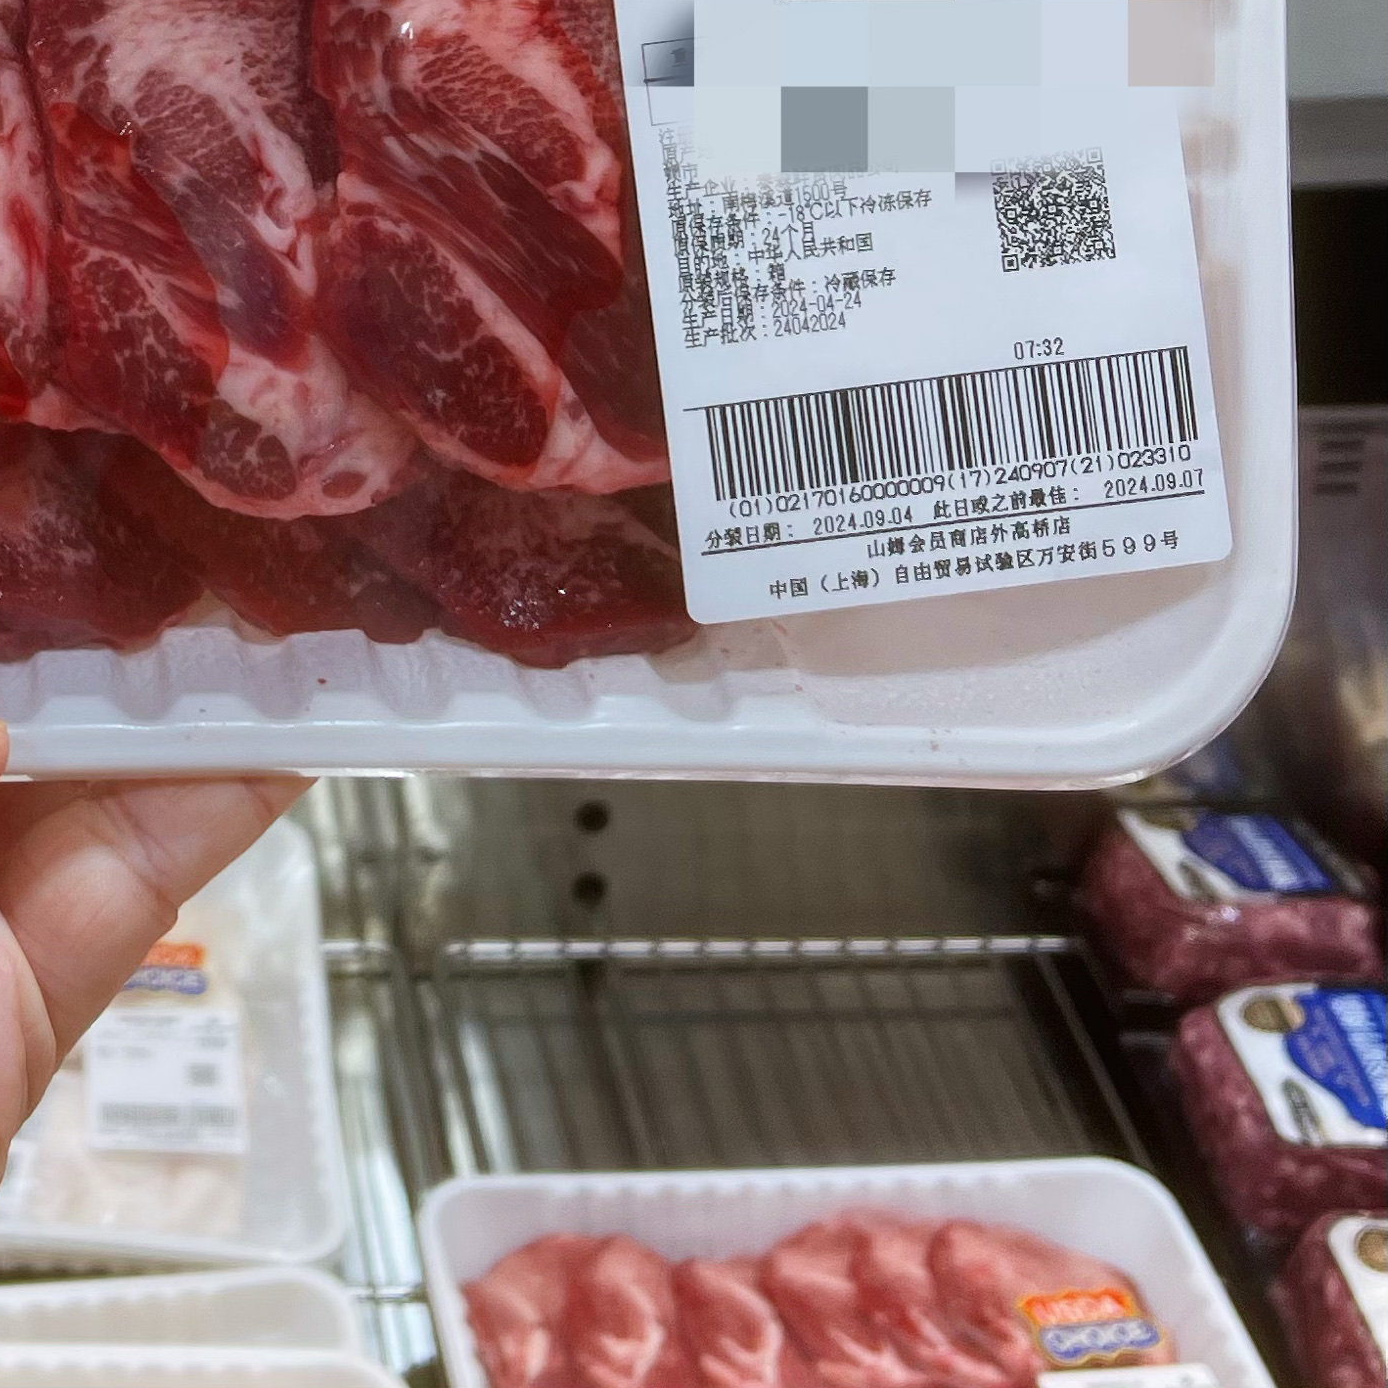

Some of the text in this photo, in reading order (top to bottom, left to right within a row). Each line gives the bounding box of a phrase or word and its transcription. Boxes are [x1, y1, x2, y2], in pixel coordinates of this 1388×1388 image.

[1013, 336, 1065, 360] 07:32
[813, 505, 914, 536] 2024.09.04
[1103, 468, 1204, 499] 2024.09.07
